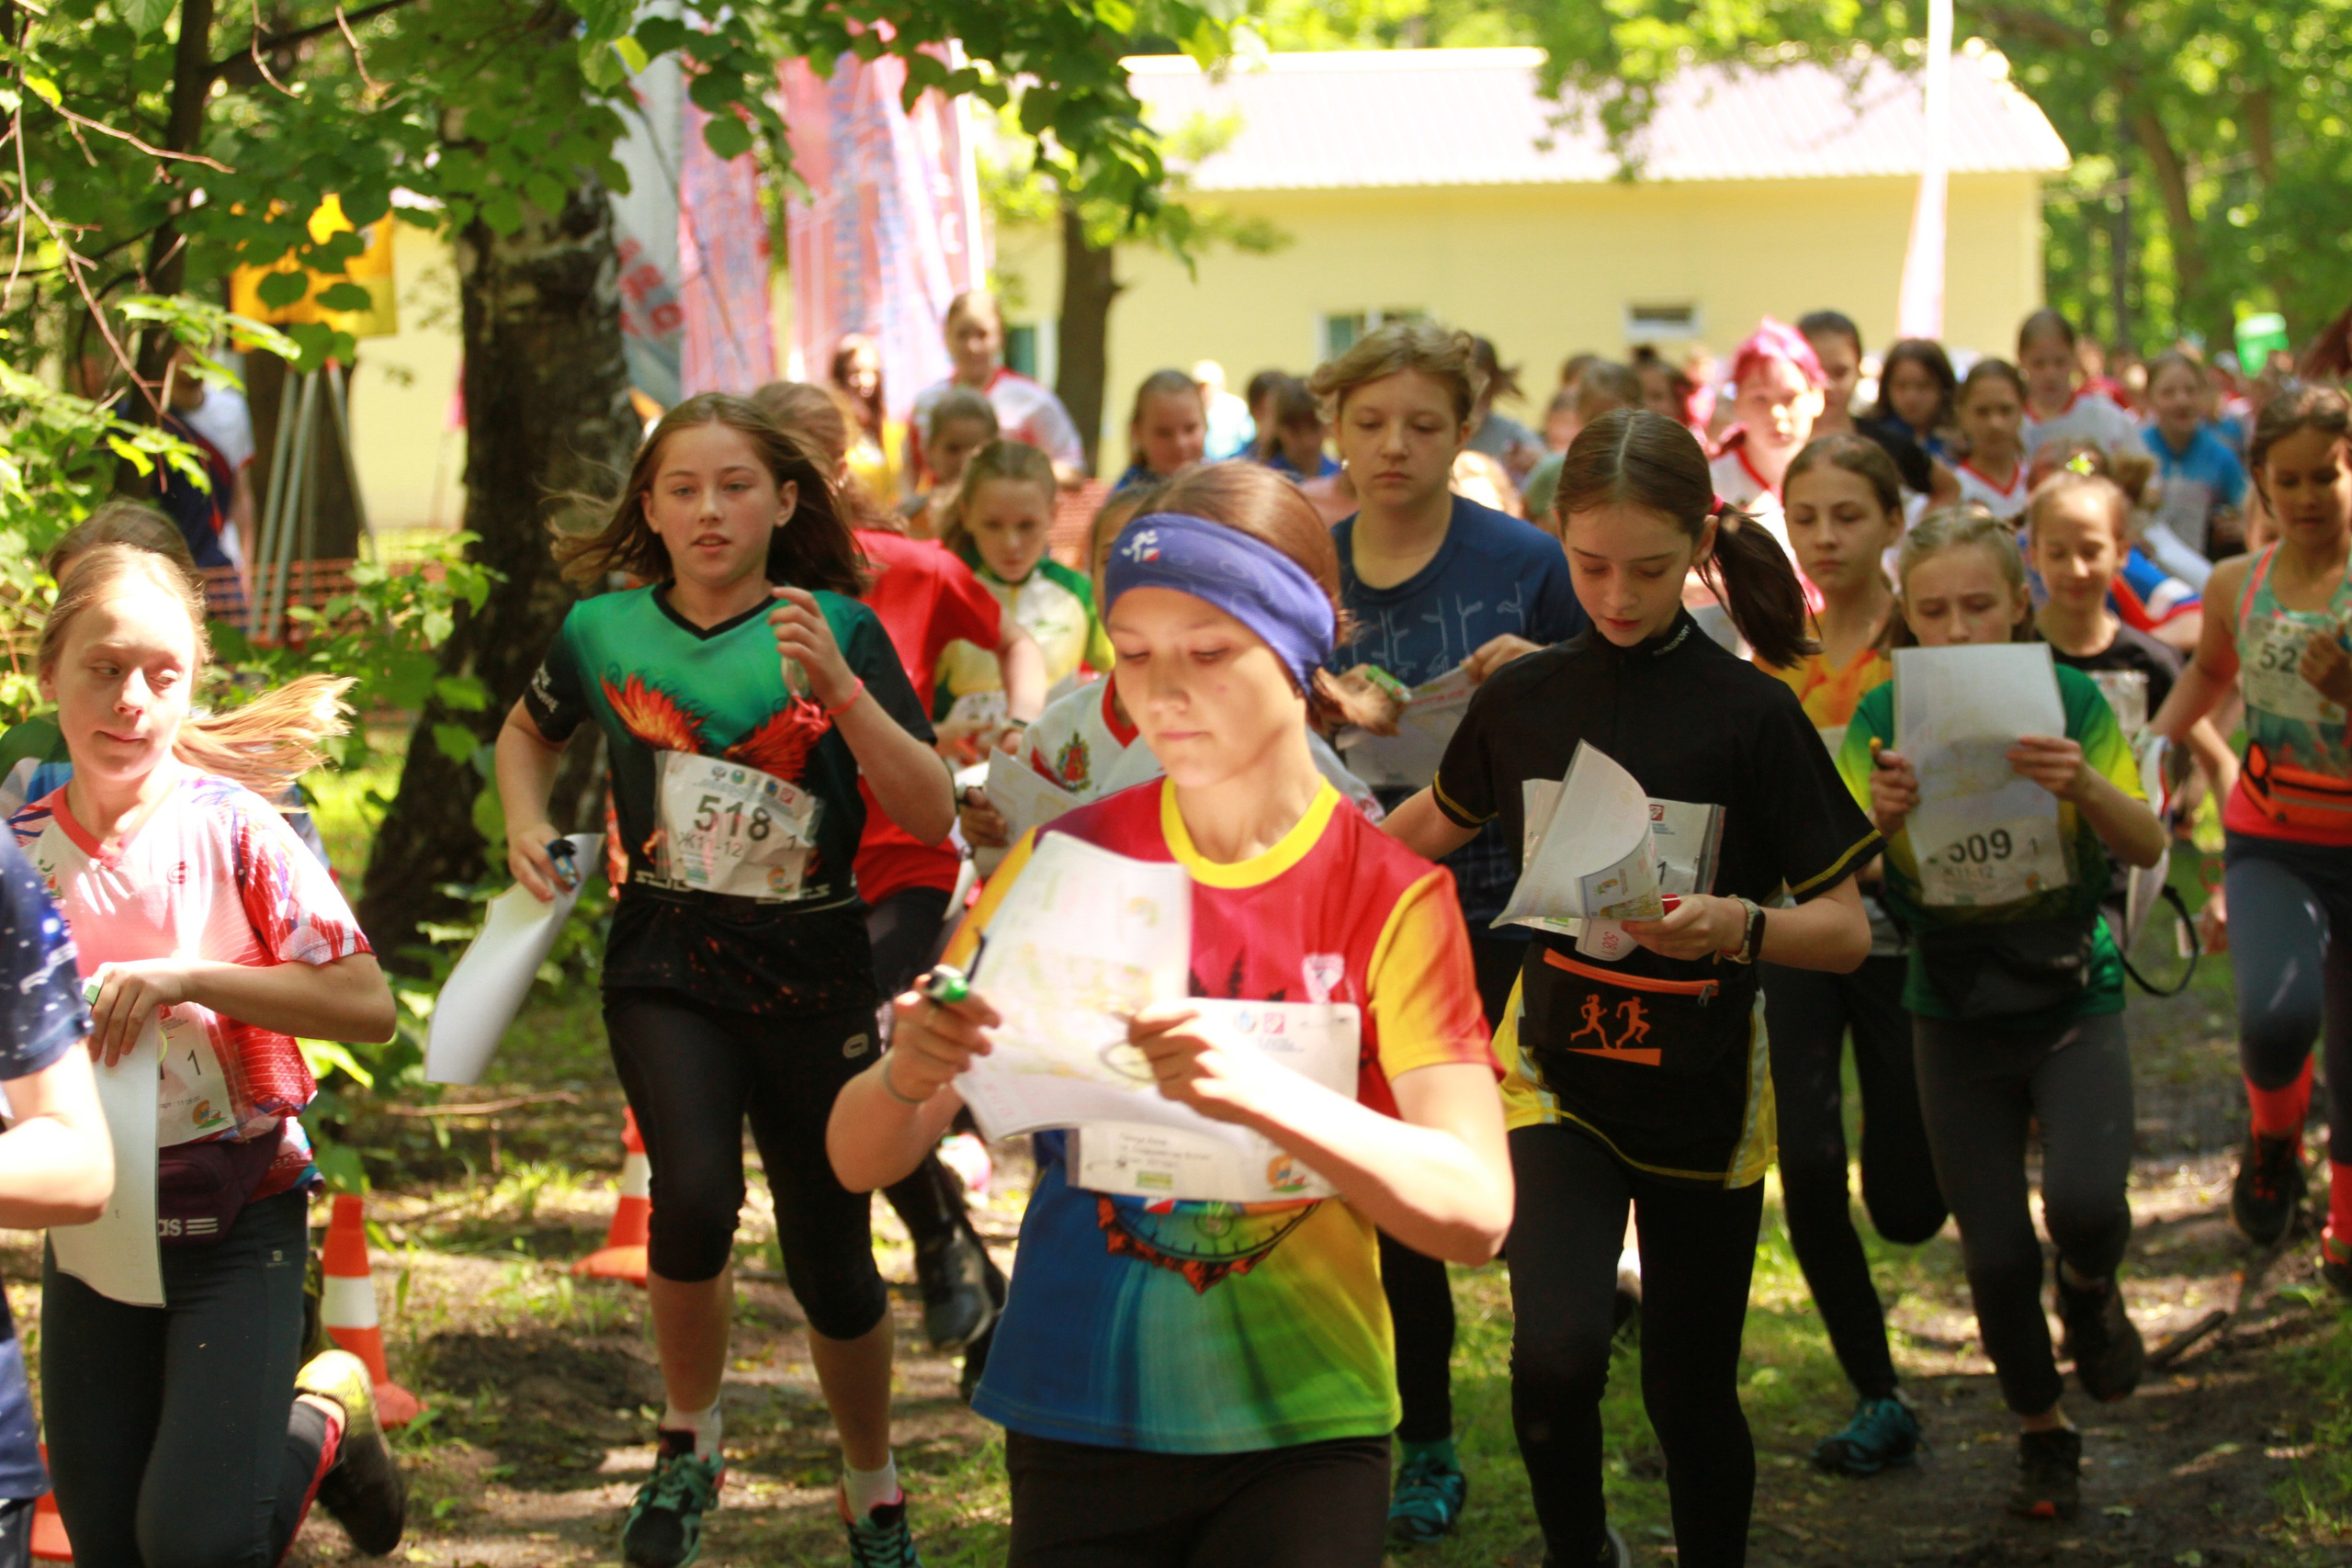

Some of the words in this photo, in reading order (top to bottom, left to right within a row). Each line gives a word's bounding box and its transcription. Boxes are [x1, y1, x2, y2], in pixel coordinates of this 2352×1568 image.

[2259, 642, 2297, 673] 52
[693, 795, 772, 841] 518
[187, 1049, 201, 1076] 1
